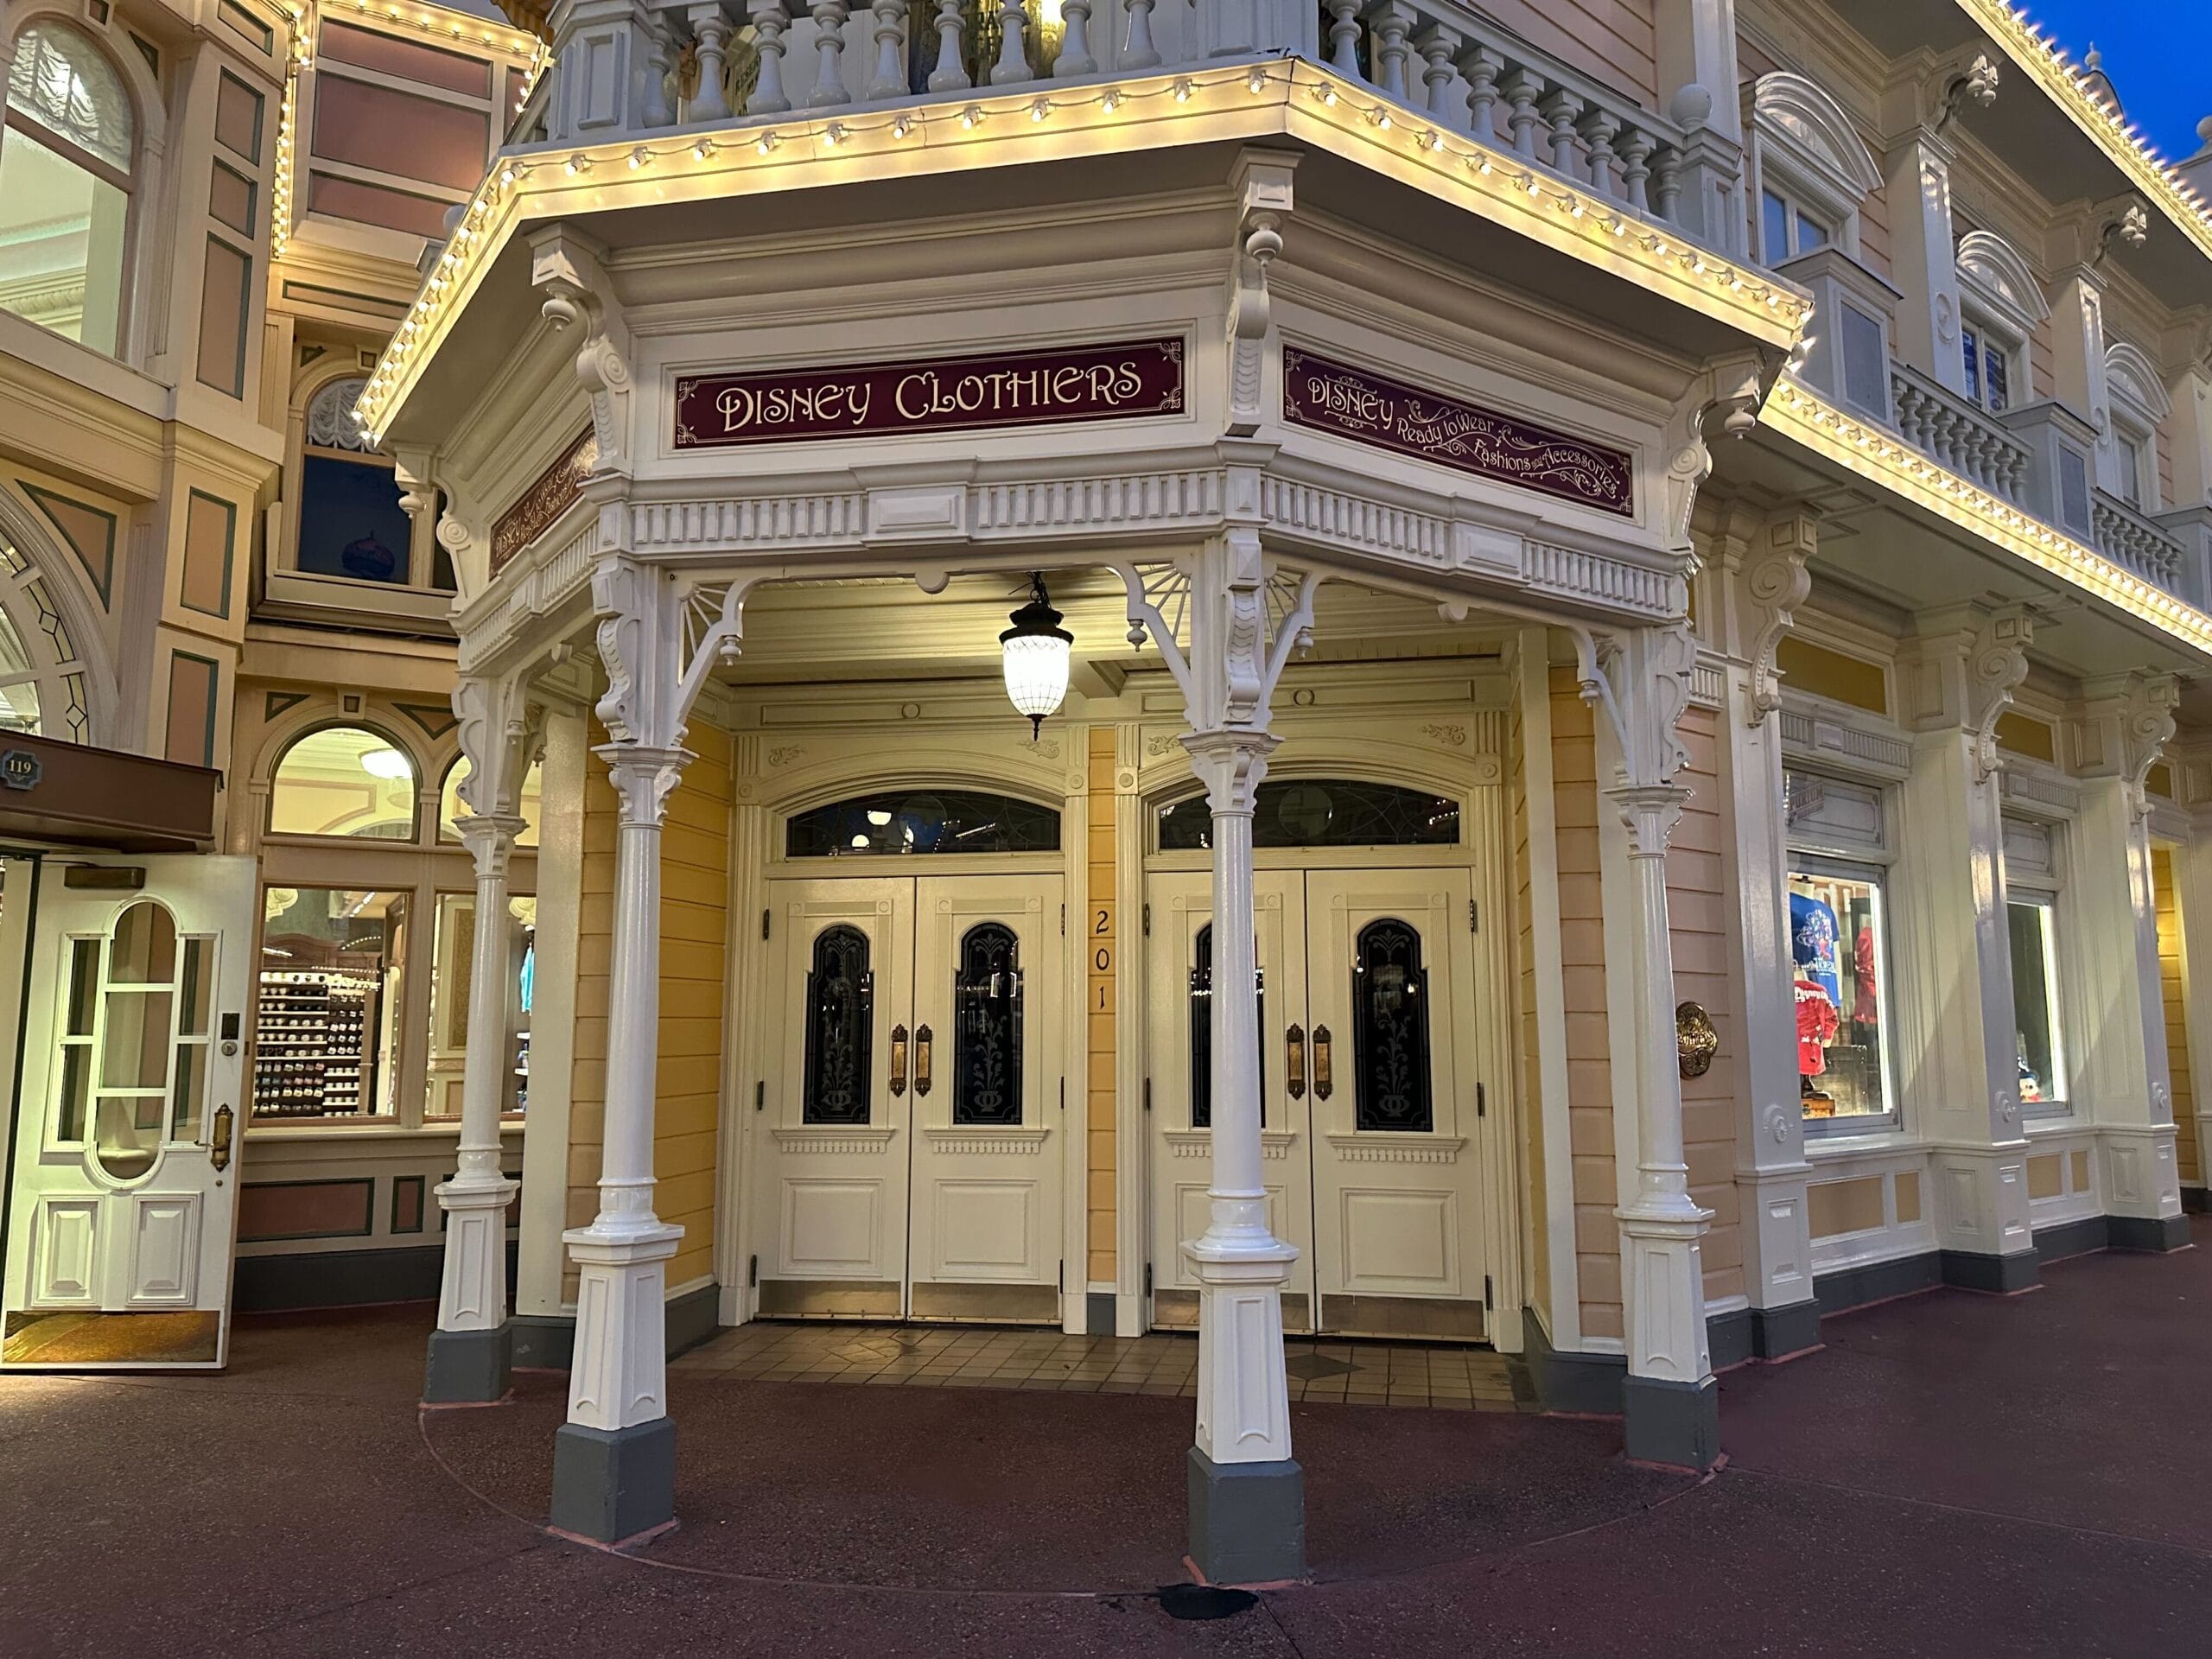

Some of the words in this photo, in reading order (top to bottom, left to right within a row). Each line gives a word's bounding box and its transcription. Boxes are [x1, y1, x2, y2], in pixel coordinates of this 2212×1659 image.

[895, 361, 1141, 420] CLOTHIERS
[1397, 416, 1443, 445] Ready
[1455, 412, 1495, 434] Wear
[1474, 437, 1532, 471] Fashions
[1542, 447, 1618, 495] Accessories
[9, 760, 32, 774] 119
